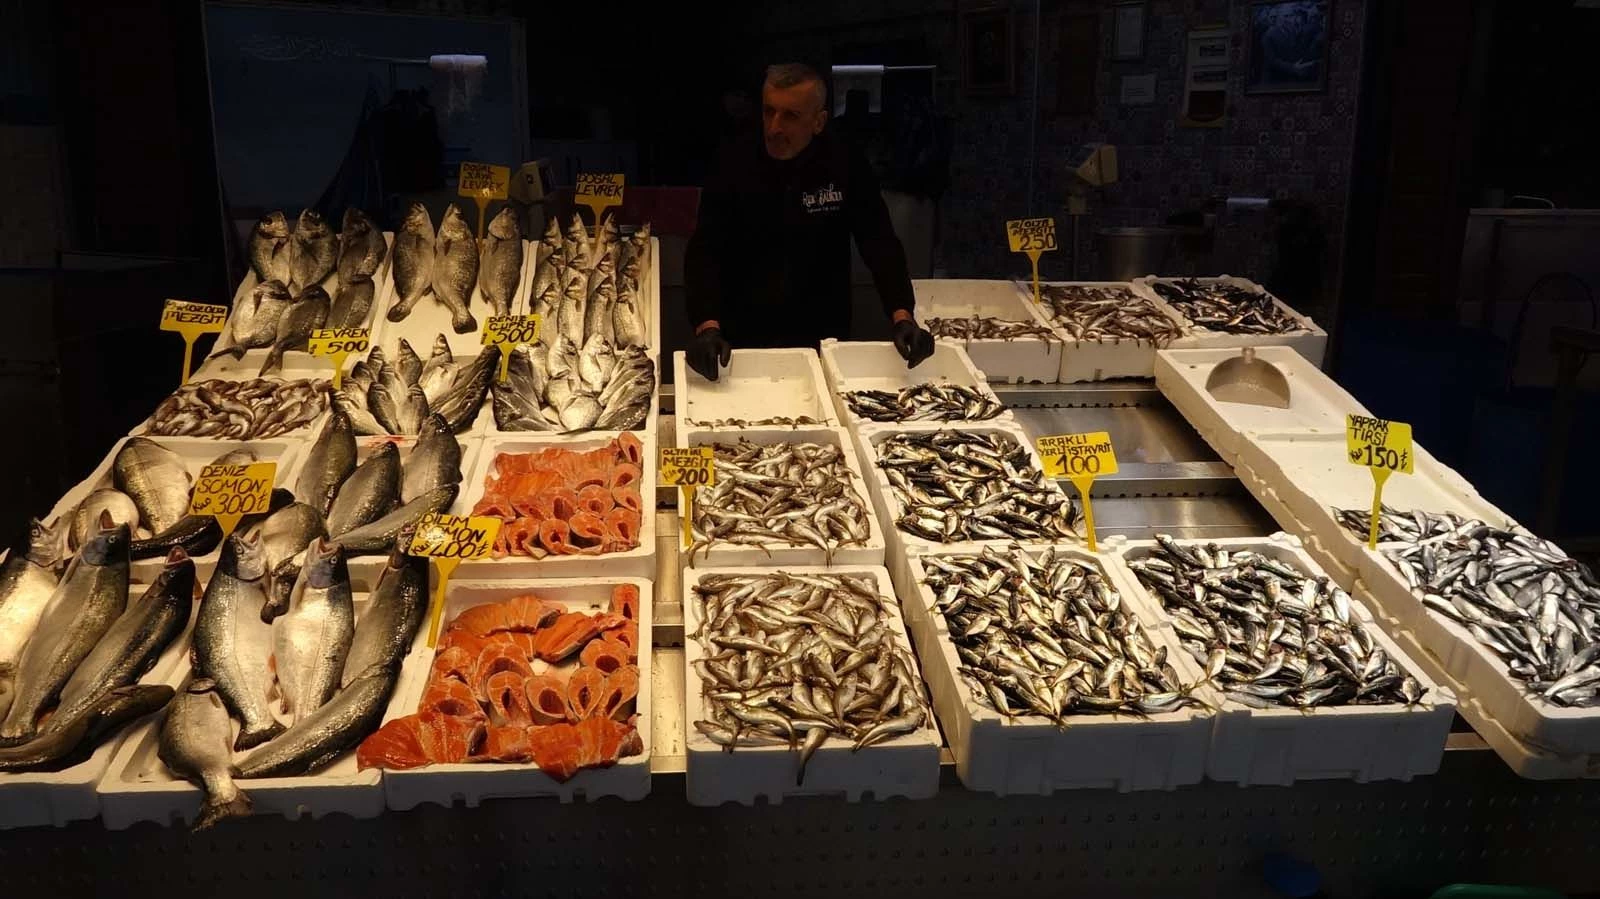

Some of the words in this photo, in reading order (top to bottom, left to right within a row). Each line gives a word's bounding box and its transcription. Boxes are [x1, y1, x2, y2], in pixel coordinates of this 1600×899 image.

[576, 184, 623, 197] LEVREK
[1020, 233, 1056, 250] 250
[308, 328, 369, 339] LEVREK
[492, 328, 535, 344] 500
[325, 340, 369, 354] 500
[1349, 414, 1389, 432] YAPRAK
[1056, 455, 1100, 475] 100
[675, 468, 709, 485] 200
[197, 478, 268, 494] SOMON
